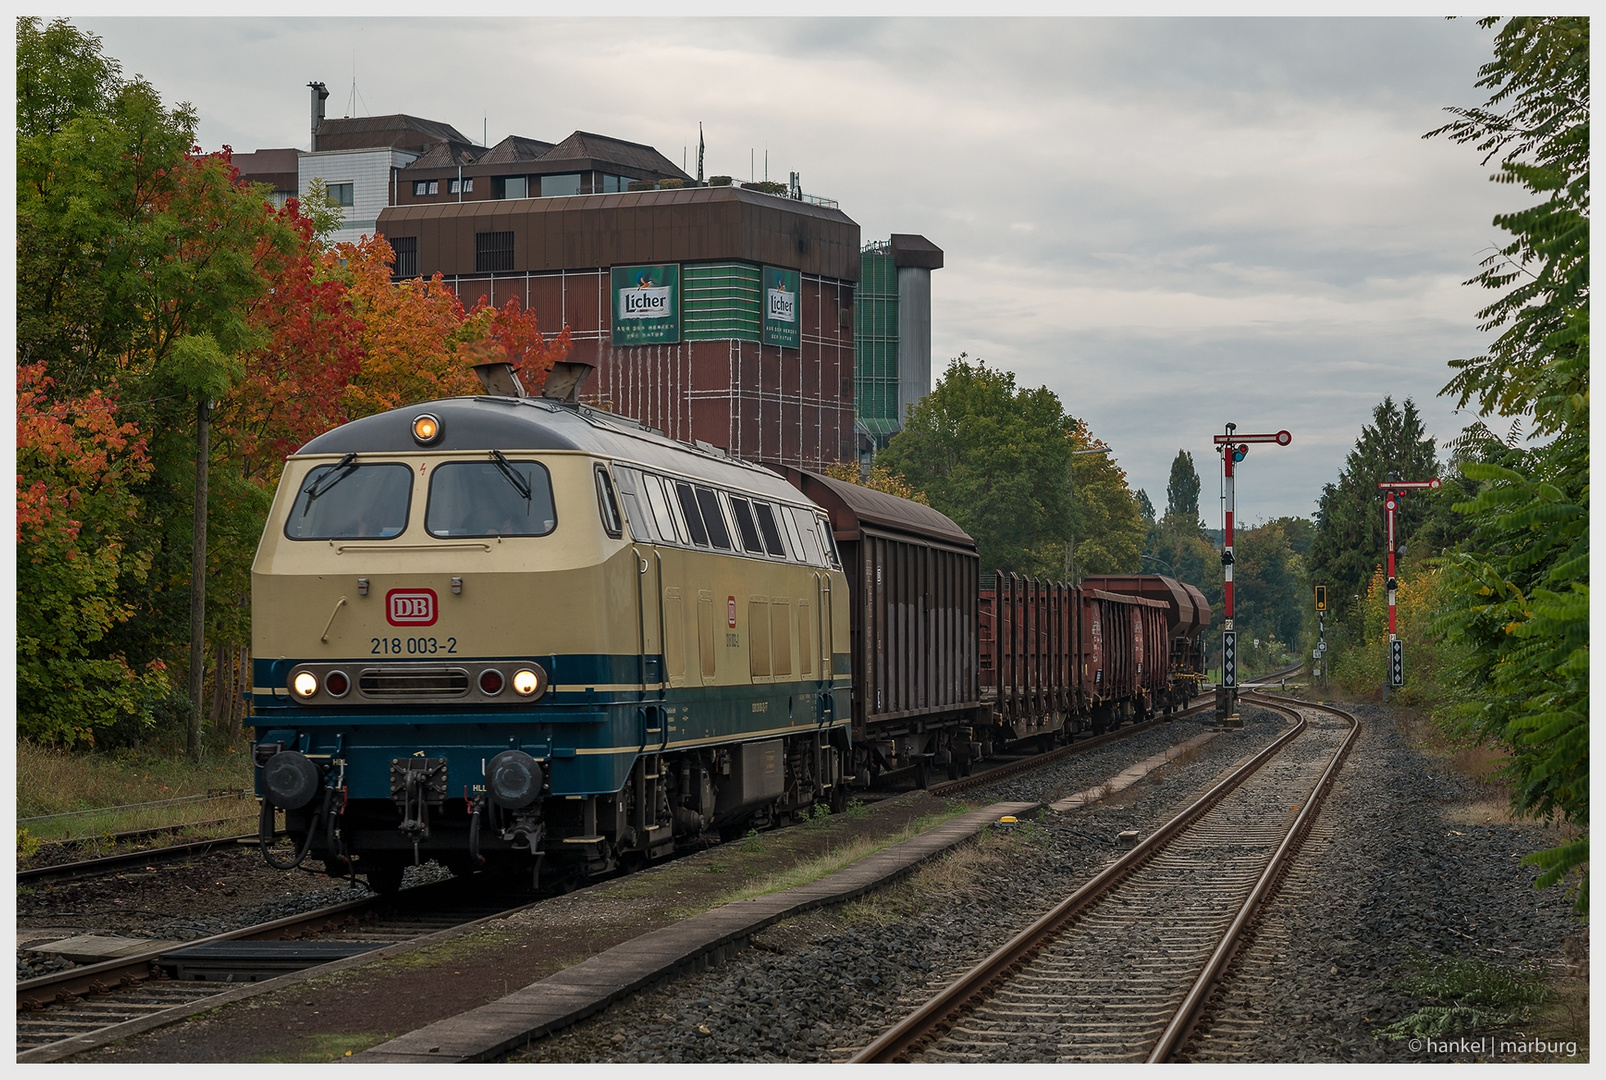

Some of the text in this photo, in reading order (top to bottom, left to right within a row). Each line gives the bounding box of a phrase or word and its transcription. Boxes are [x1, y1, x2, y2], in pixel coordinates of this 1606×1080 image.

[625, 292, 667, 313] Licher
[770, 295, 793, 314] Licher
[395, 598, 428, 617] DB
[371, 637, 458, 655] 218 003-2
